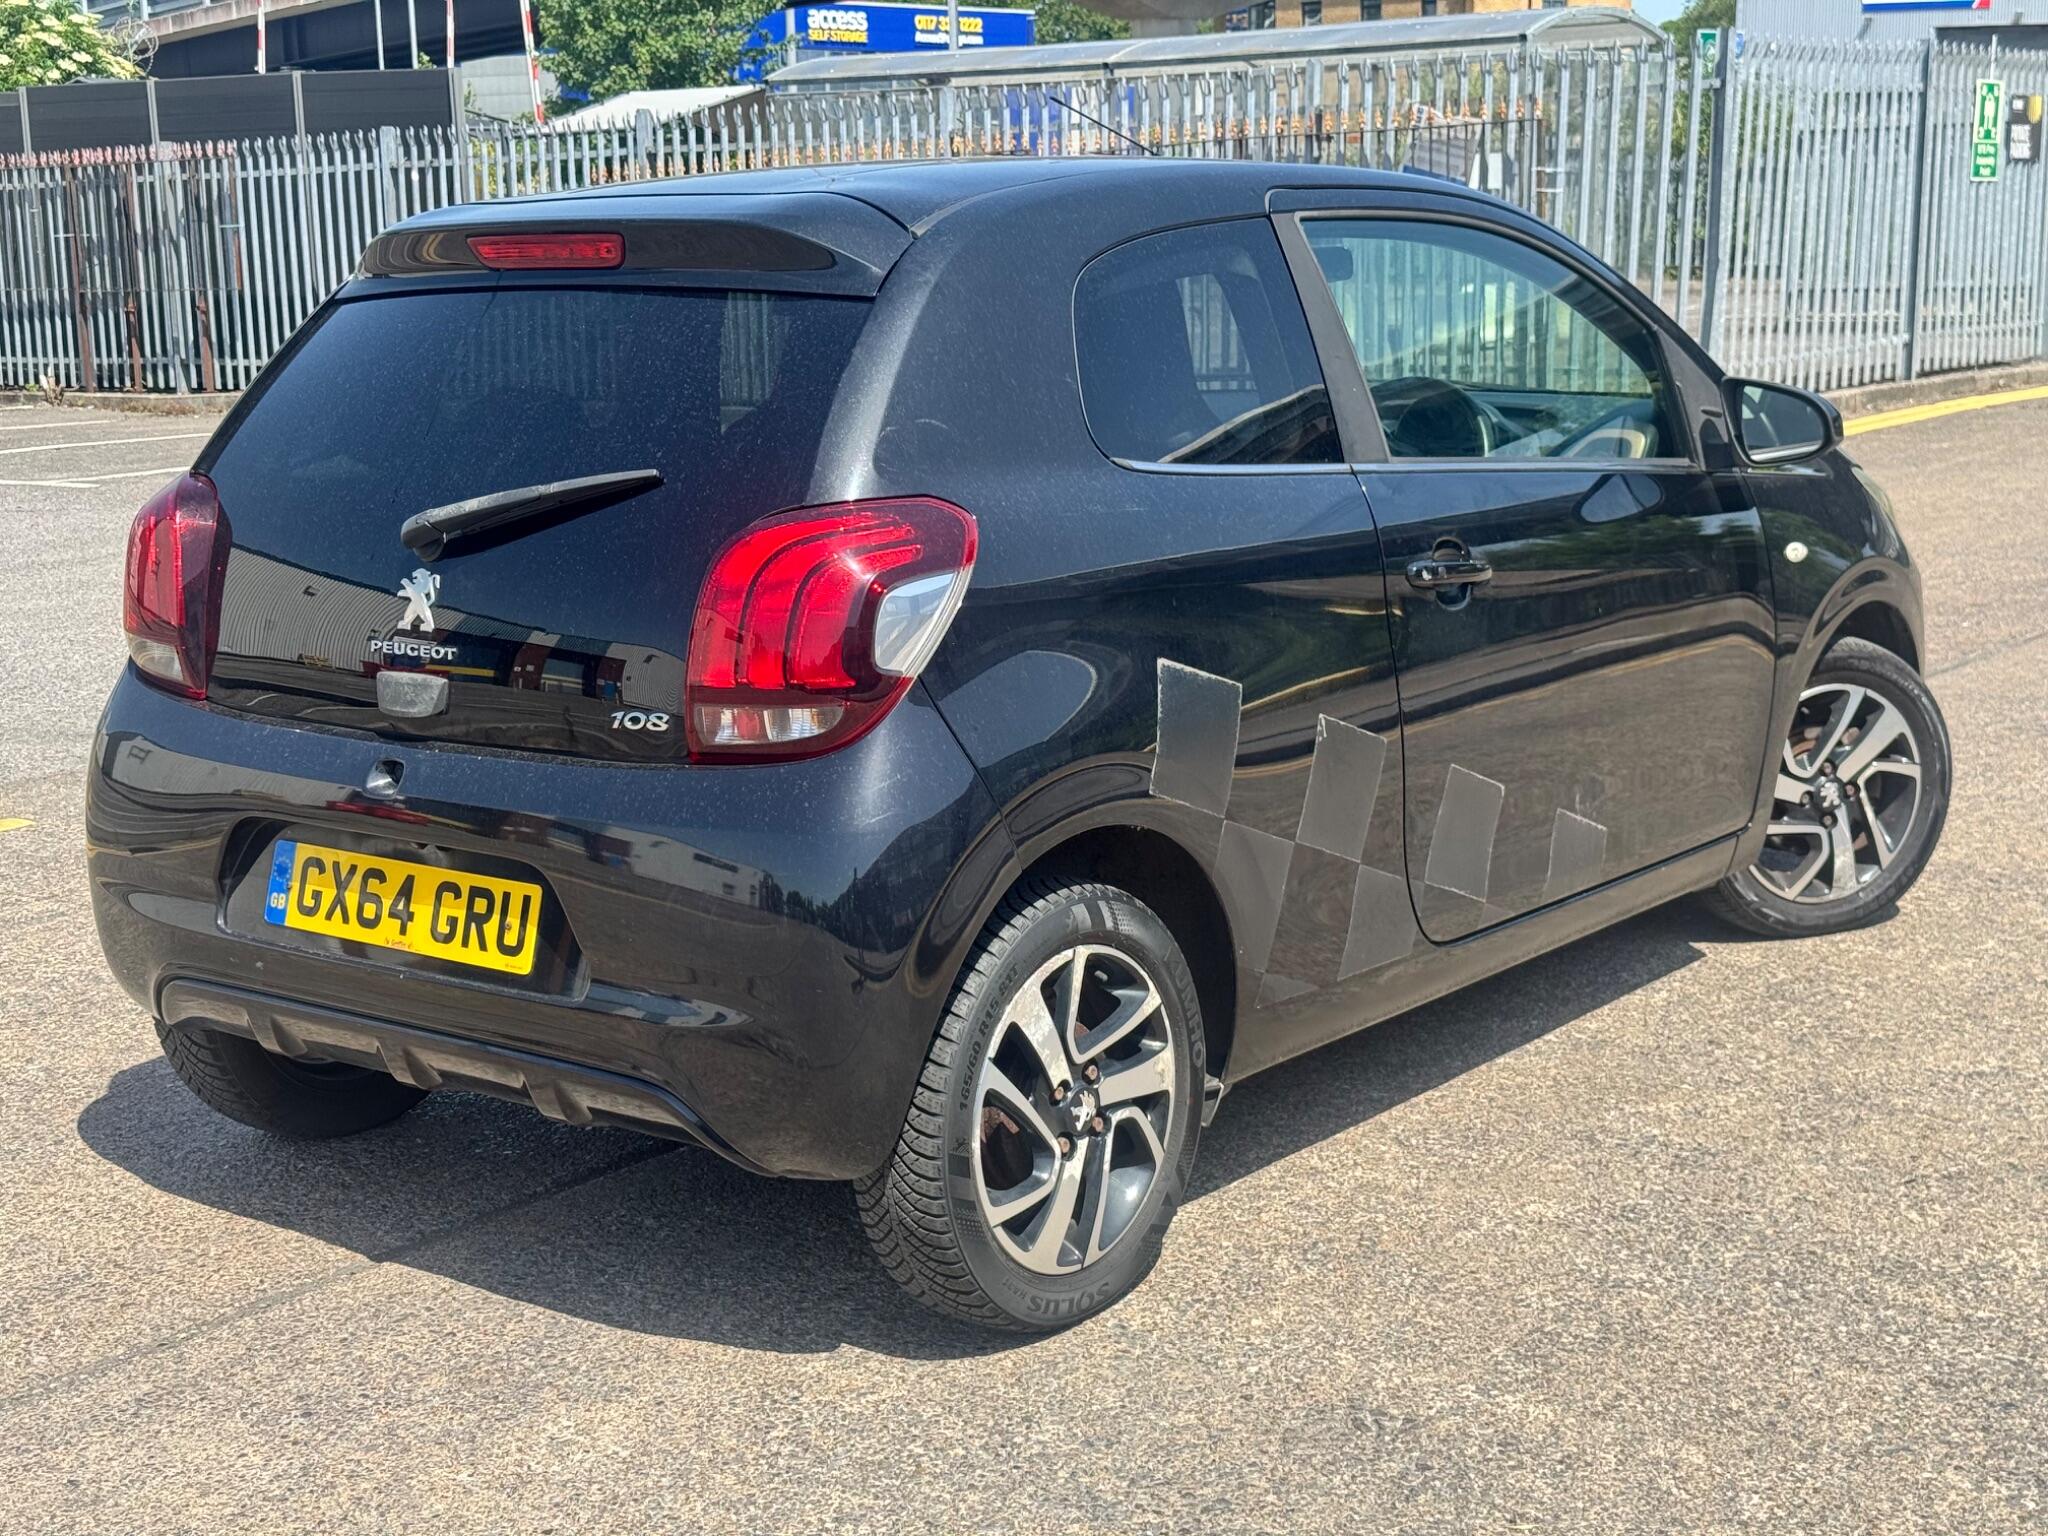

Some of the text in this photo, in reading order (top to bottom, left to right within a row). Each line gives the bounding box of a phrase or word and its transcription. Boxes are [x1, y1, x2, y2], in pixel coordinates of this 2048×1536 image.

[807, 9, 868, 31] access
[808, 29, 869, 43] SELF STORAGE
[369, 639, 457, 661] PEUGEOT
[609, 711, 670, 732] 108
[270, 892, 285, 908] GB
[296, 855, 533, 958] GX64 GRU
[959, 1041, 982, 1112] 165/60
[977, 996, 1001, 1037] R15
[1026, 1282, 1110, 1316] SOLUS
